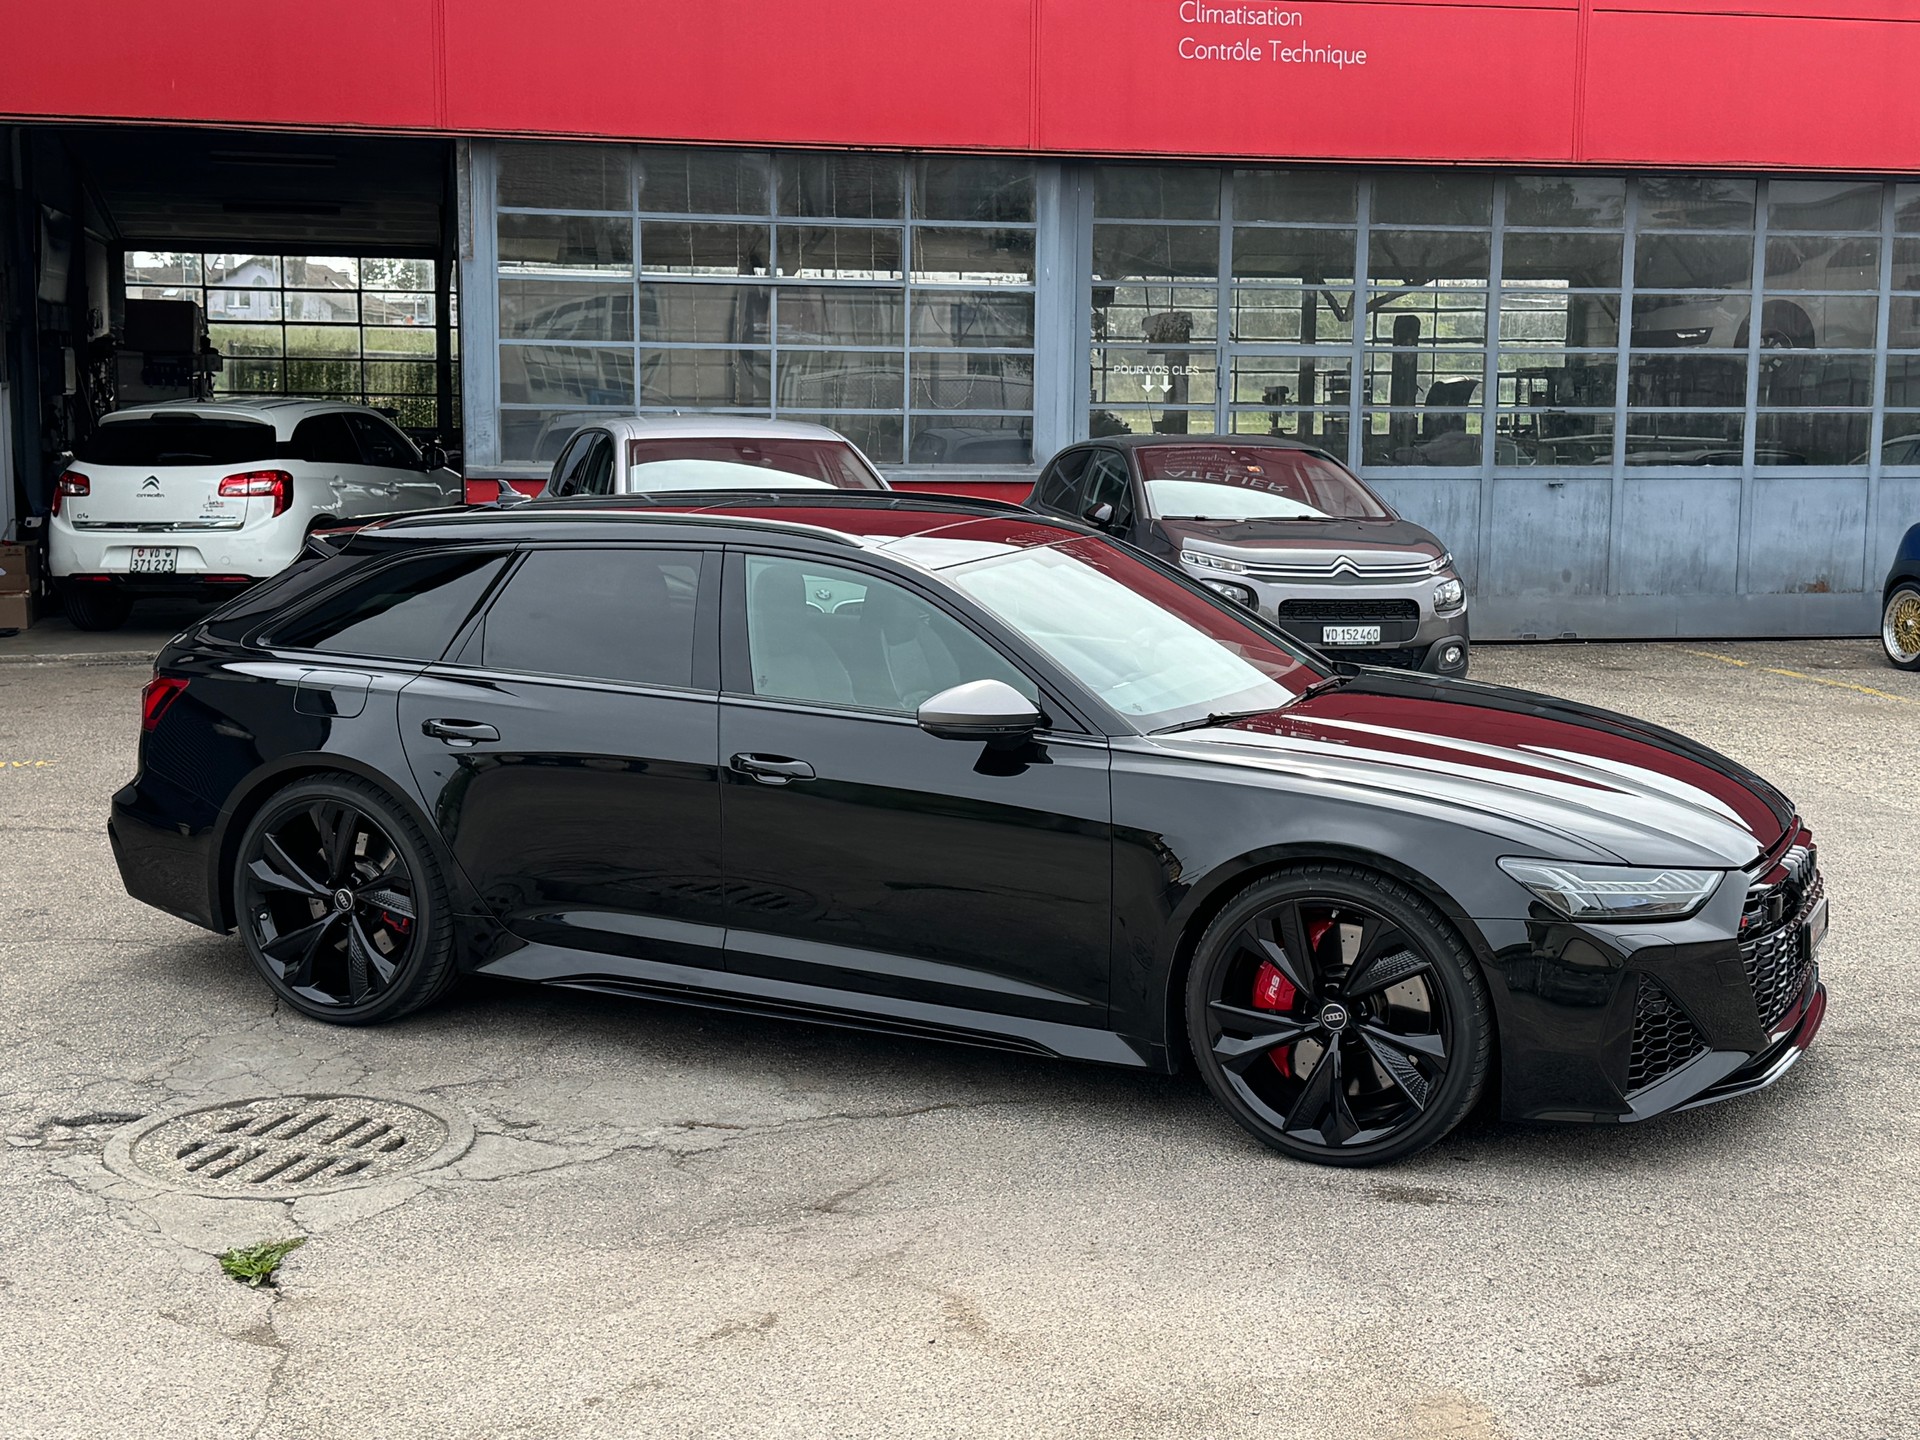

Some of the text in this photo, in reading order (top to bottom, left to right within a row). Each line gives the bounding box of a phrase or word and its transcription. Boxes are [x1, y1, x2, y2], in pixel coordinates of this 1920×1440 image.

[1179, 0, 1303, 26] Climatisation
[1178, 37, 1367, 70] Contrôle Technique
[1113, 365, 1200, 376] POUR VOS CLES
[1268, 974, 1280, 999] RS
